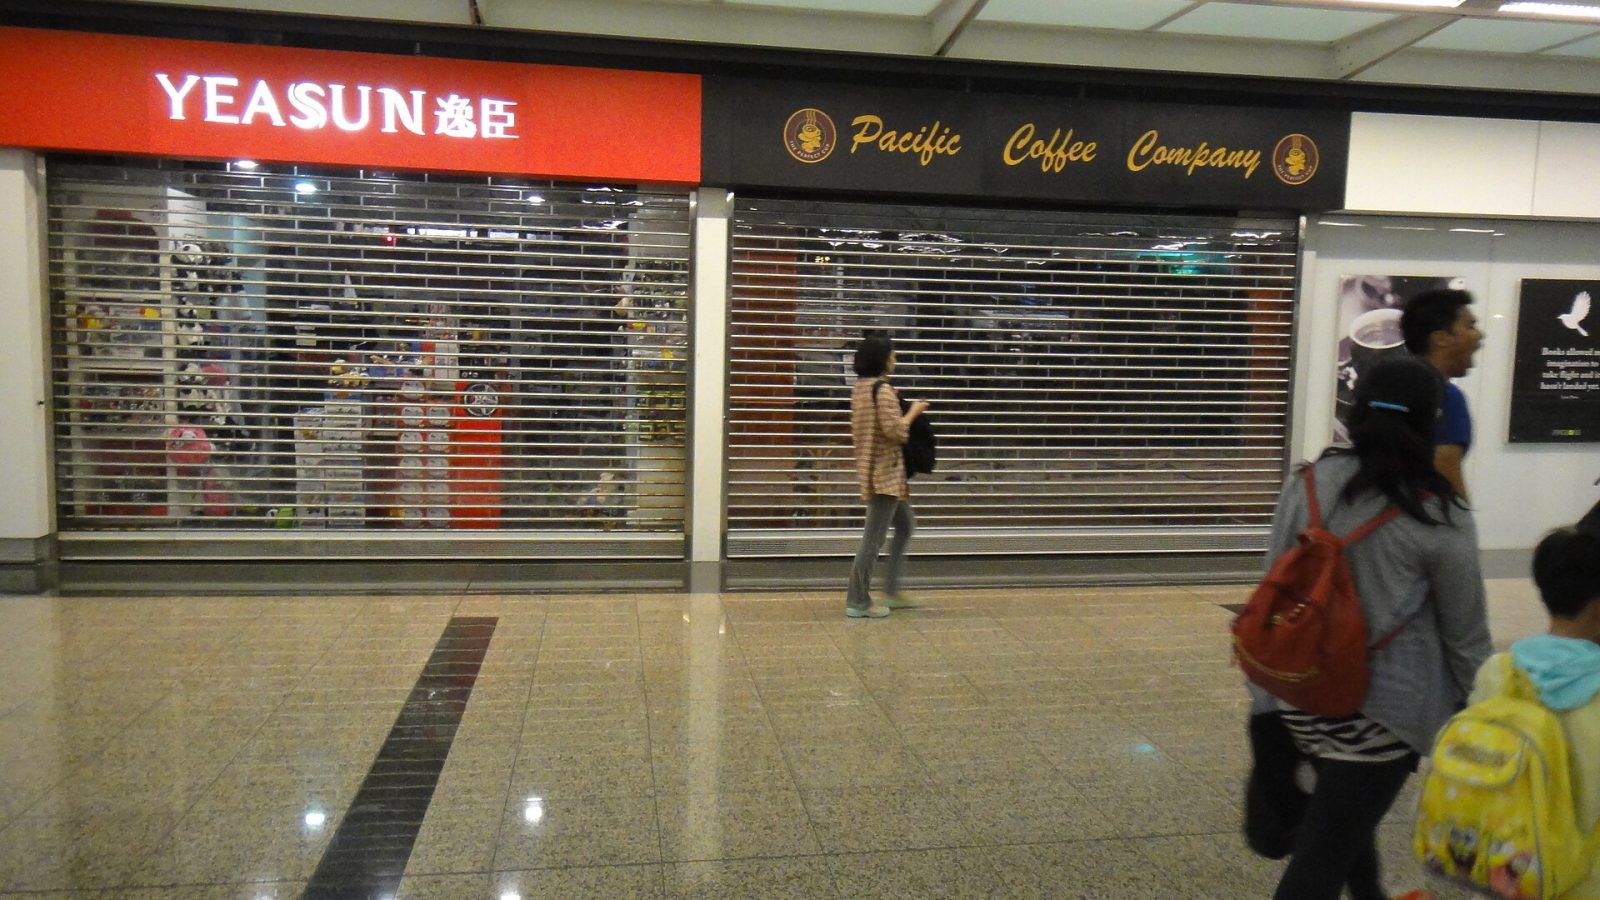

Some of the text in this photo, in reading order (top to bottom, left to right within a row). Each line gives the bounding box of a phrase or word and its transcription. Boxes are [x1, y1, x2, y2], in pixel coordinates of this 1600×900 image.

[155, 73, 520, 139] YEASUN 逸臣
[851, 114, 1261, 179] Pacific Coffee Company
[1542, 347, 1565, 356] Books
[1566, 347, 1594, 356] allowed
[1546, 359, 1590, 369] imagination
[1542, 370, 1559, 379] take
[1580, 370, 1594, 379] and
